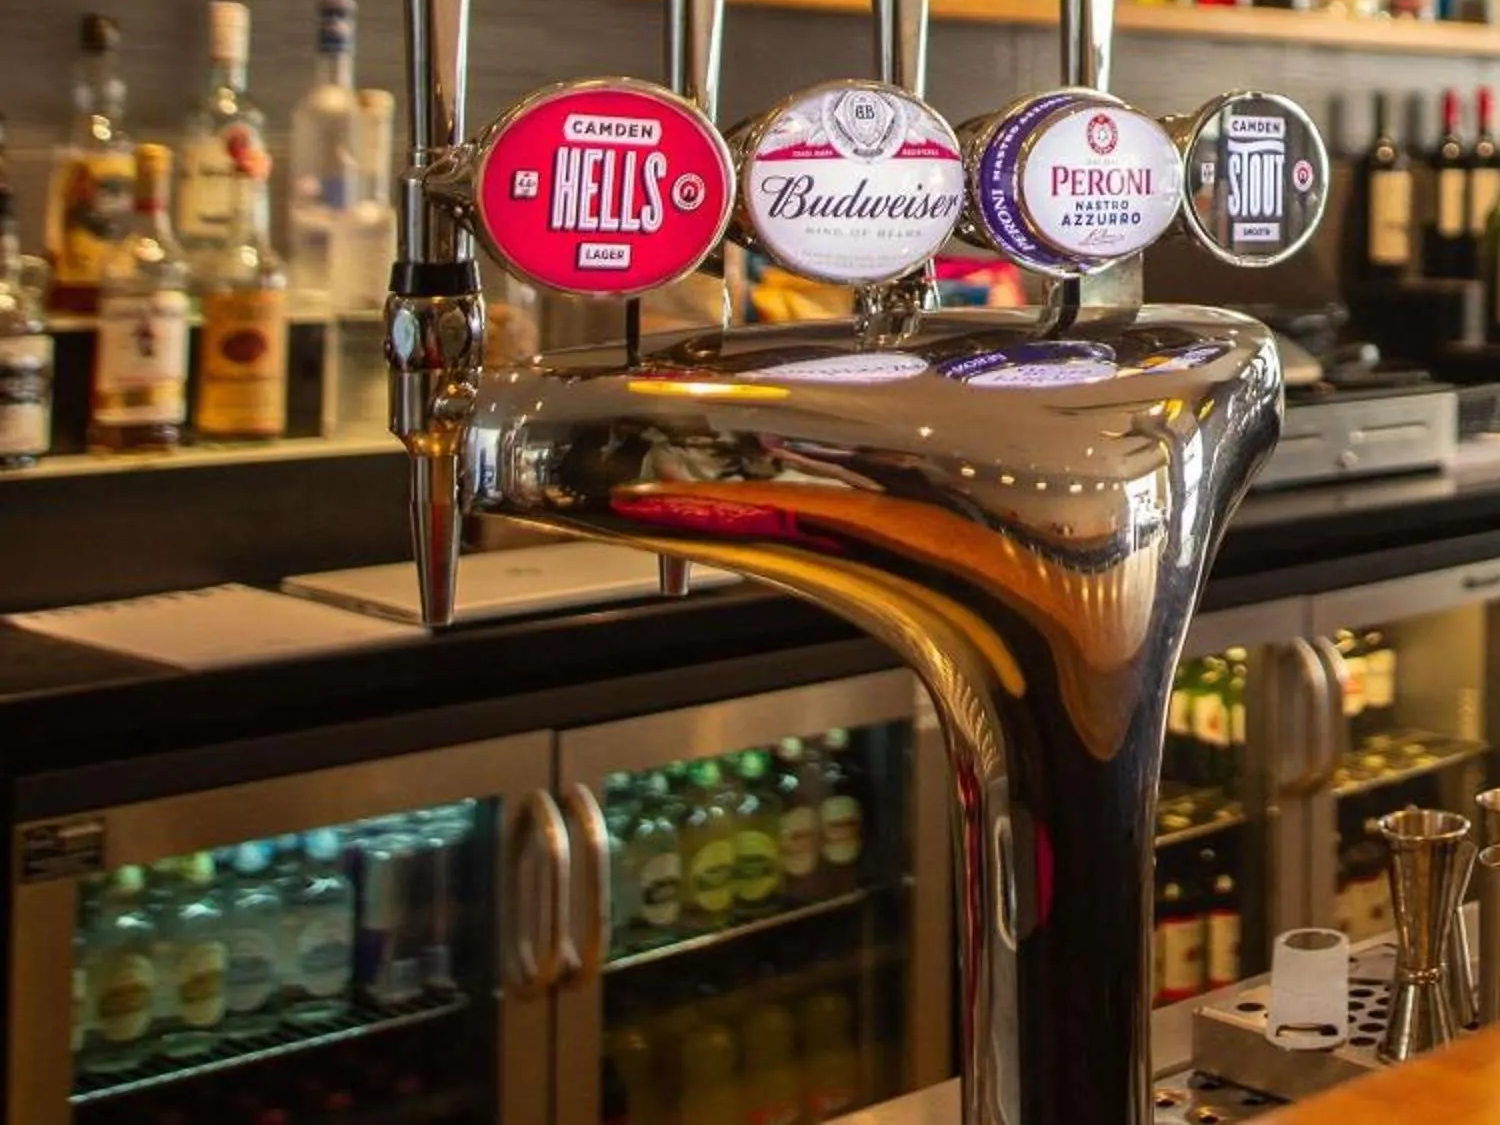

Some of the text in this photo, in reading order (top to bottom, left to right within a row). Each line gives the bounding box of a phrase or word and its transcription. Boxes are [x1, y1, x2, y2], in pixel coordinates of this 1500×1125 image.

[572, 120, 654, 139] CAMDEN
[1231, 119, 1281, 133] CAMDEN
[550, 146, 667, 233] HELLS
[1051, 166, 1152, 196] PERONI
[1227, 138, 1285, 218] STOUT
[761, 174, 959, 220] Budweiser
[1075, 200, 1129, 211] NASTRO
[991, 189, 1036, 252] PERONI
[1061, 212, 1142, 226] AZZURRO
[585, 247, 625, 261] LAGER
